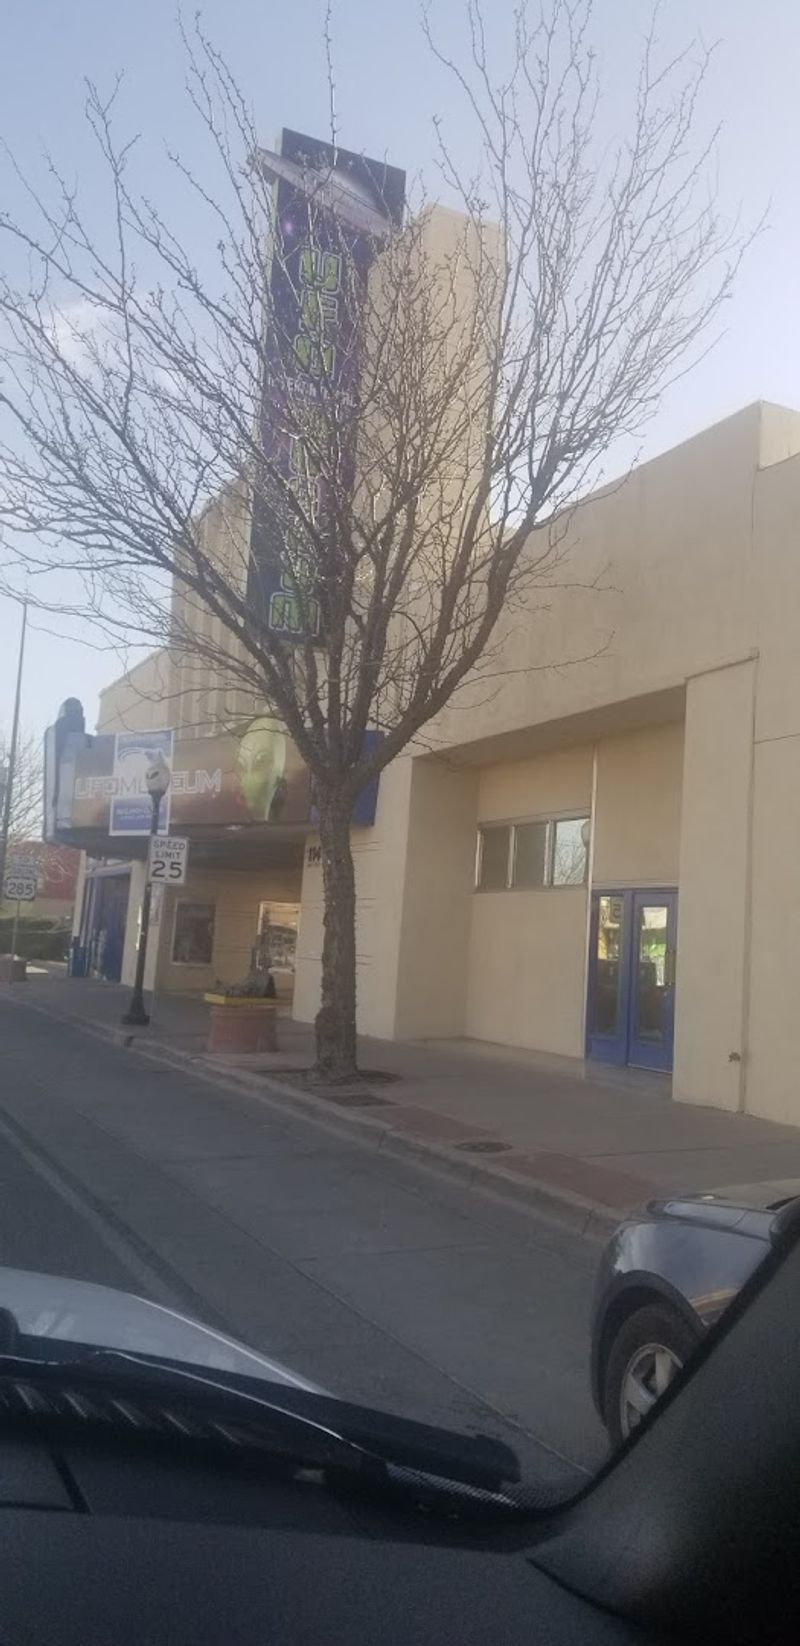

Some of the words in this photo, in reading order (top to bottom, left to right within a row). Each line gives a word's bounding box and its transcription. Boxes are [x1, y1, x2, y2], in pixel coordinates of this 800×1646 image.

[119, 767, 221, 795] MUEUM
[153, 838, 186, 850] SPEED
[155, 850, 181, 860] LIMIT
[151, 860, 183, 879] 25
[8, 882, 33, 896] 285
